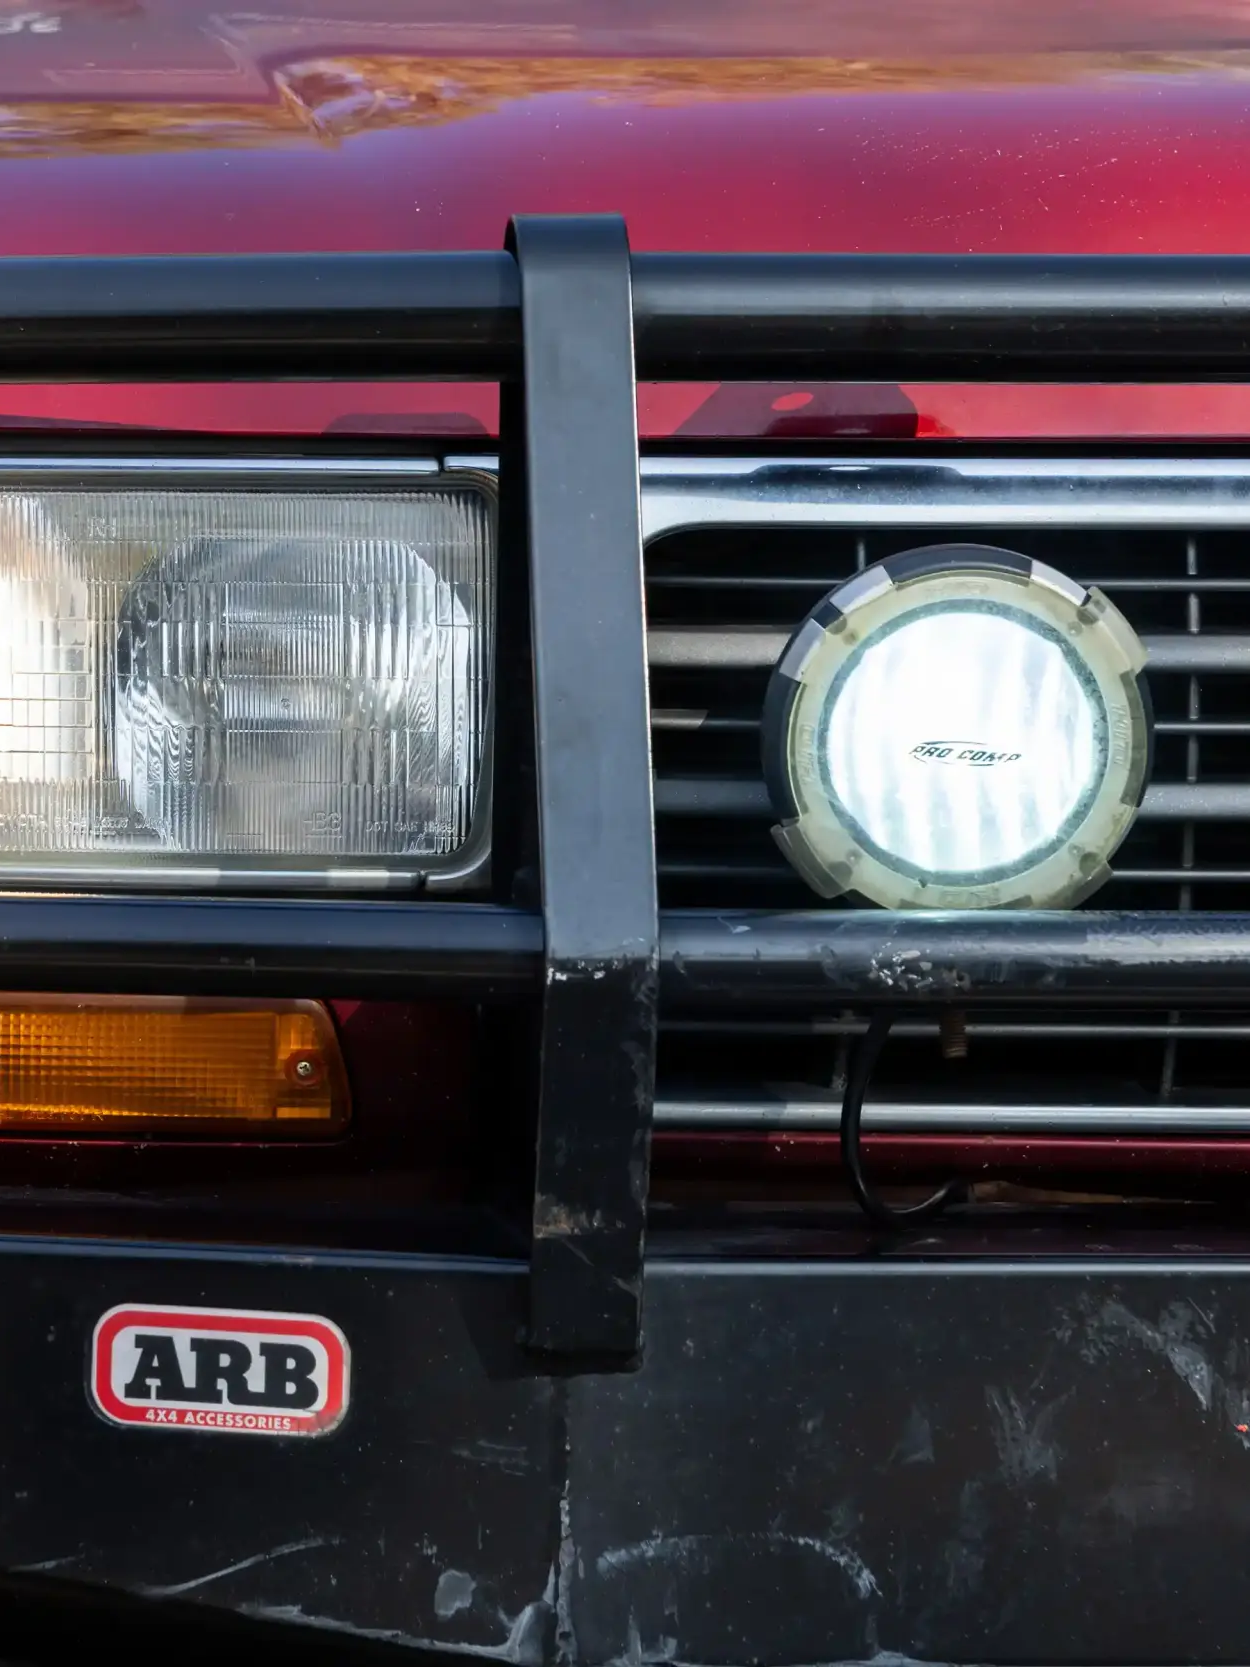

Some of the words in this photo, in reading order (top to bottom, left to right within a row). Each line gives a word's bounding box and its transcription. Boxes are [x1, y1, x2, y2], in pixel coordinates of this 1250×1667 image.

[908, 745, 954, 758] PRO
[956, 749, 1022, 763] COMP
[124, 1333, 319, 1410] ARB
[145, 1408, 178, 1423] 4X4
[184, 1410, 292, 1430] ACCESSORIES
